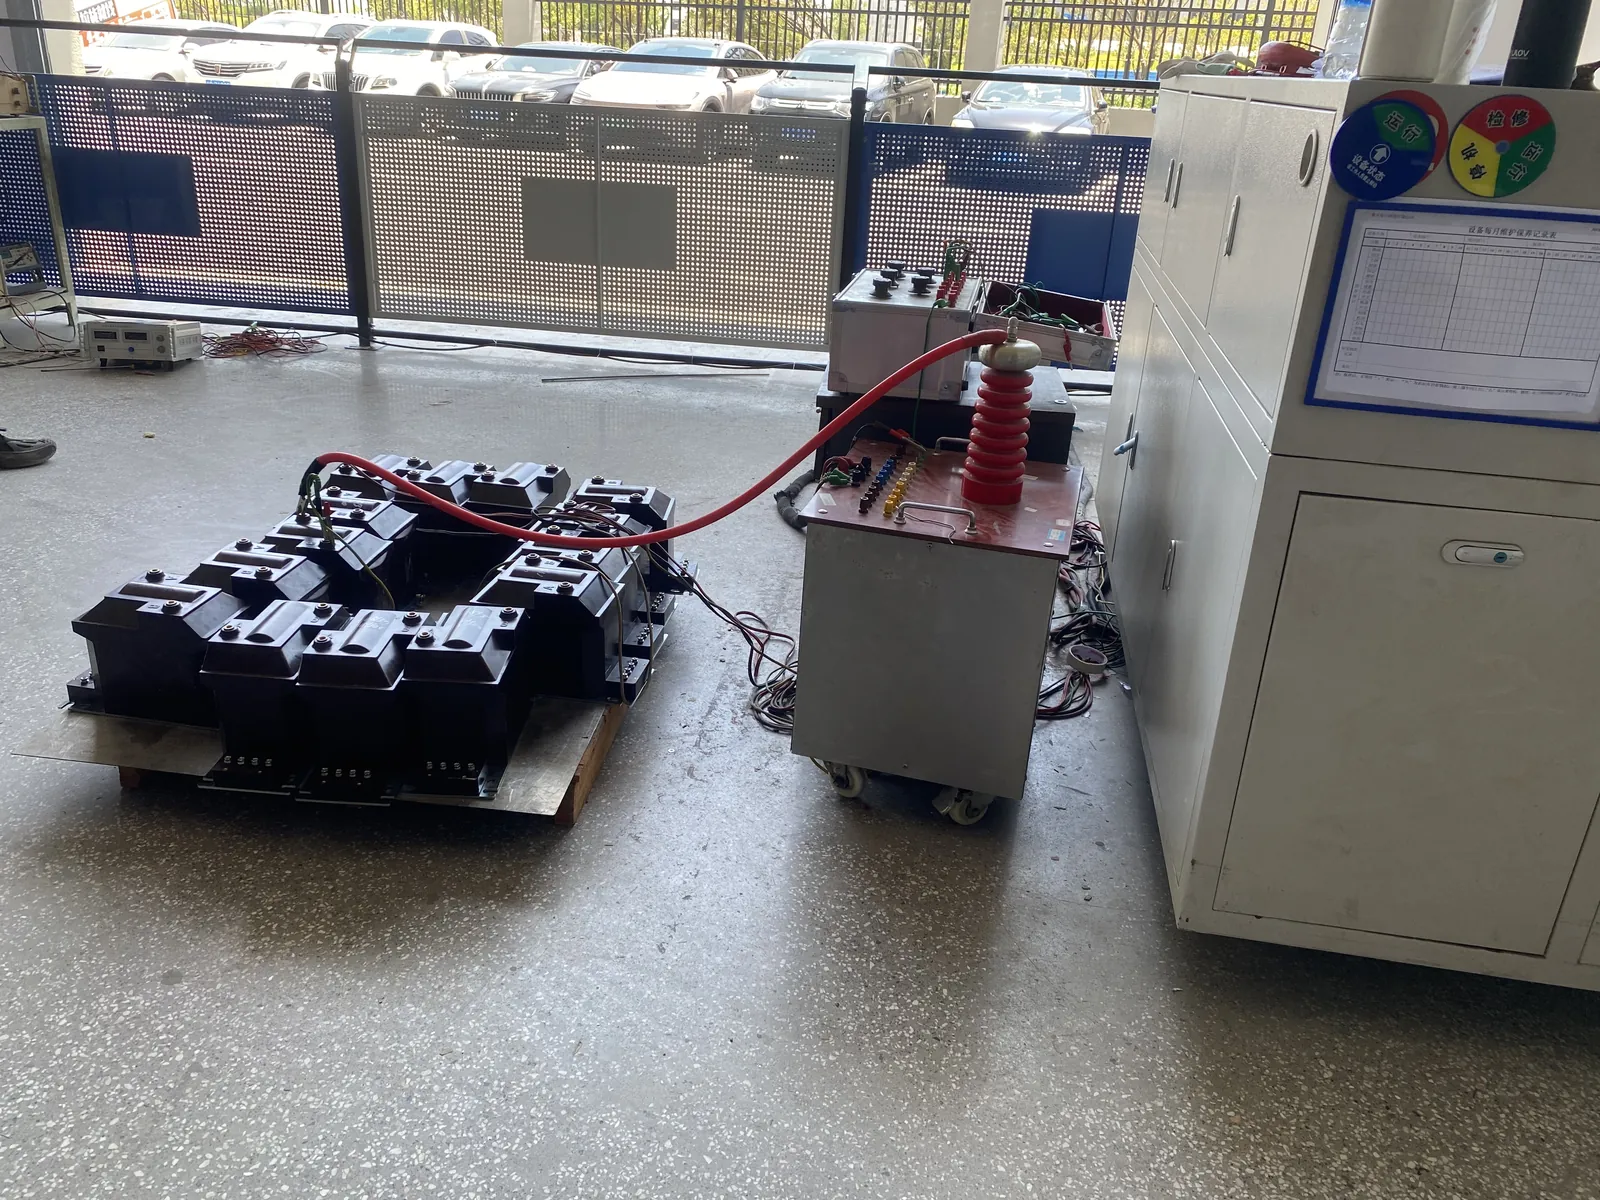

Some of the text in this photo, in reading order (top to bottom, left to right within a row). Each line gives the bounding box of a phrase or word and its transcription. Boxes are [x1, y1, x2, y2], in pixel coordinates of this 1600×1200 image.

[1383, 110, 1423, 143] 运行
[1486, 109, 1530, 128] 检修
[1351, 153, 1386, 182] 设备状态
[1507, 141, 1543, 181] 运行
